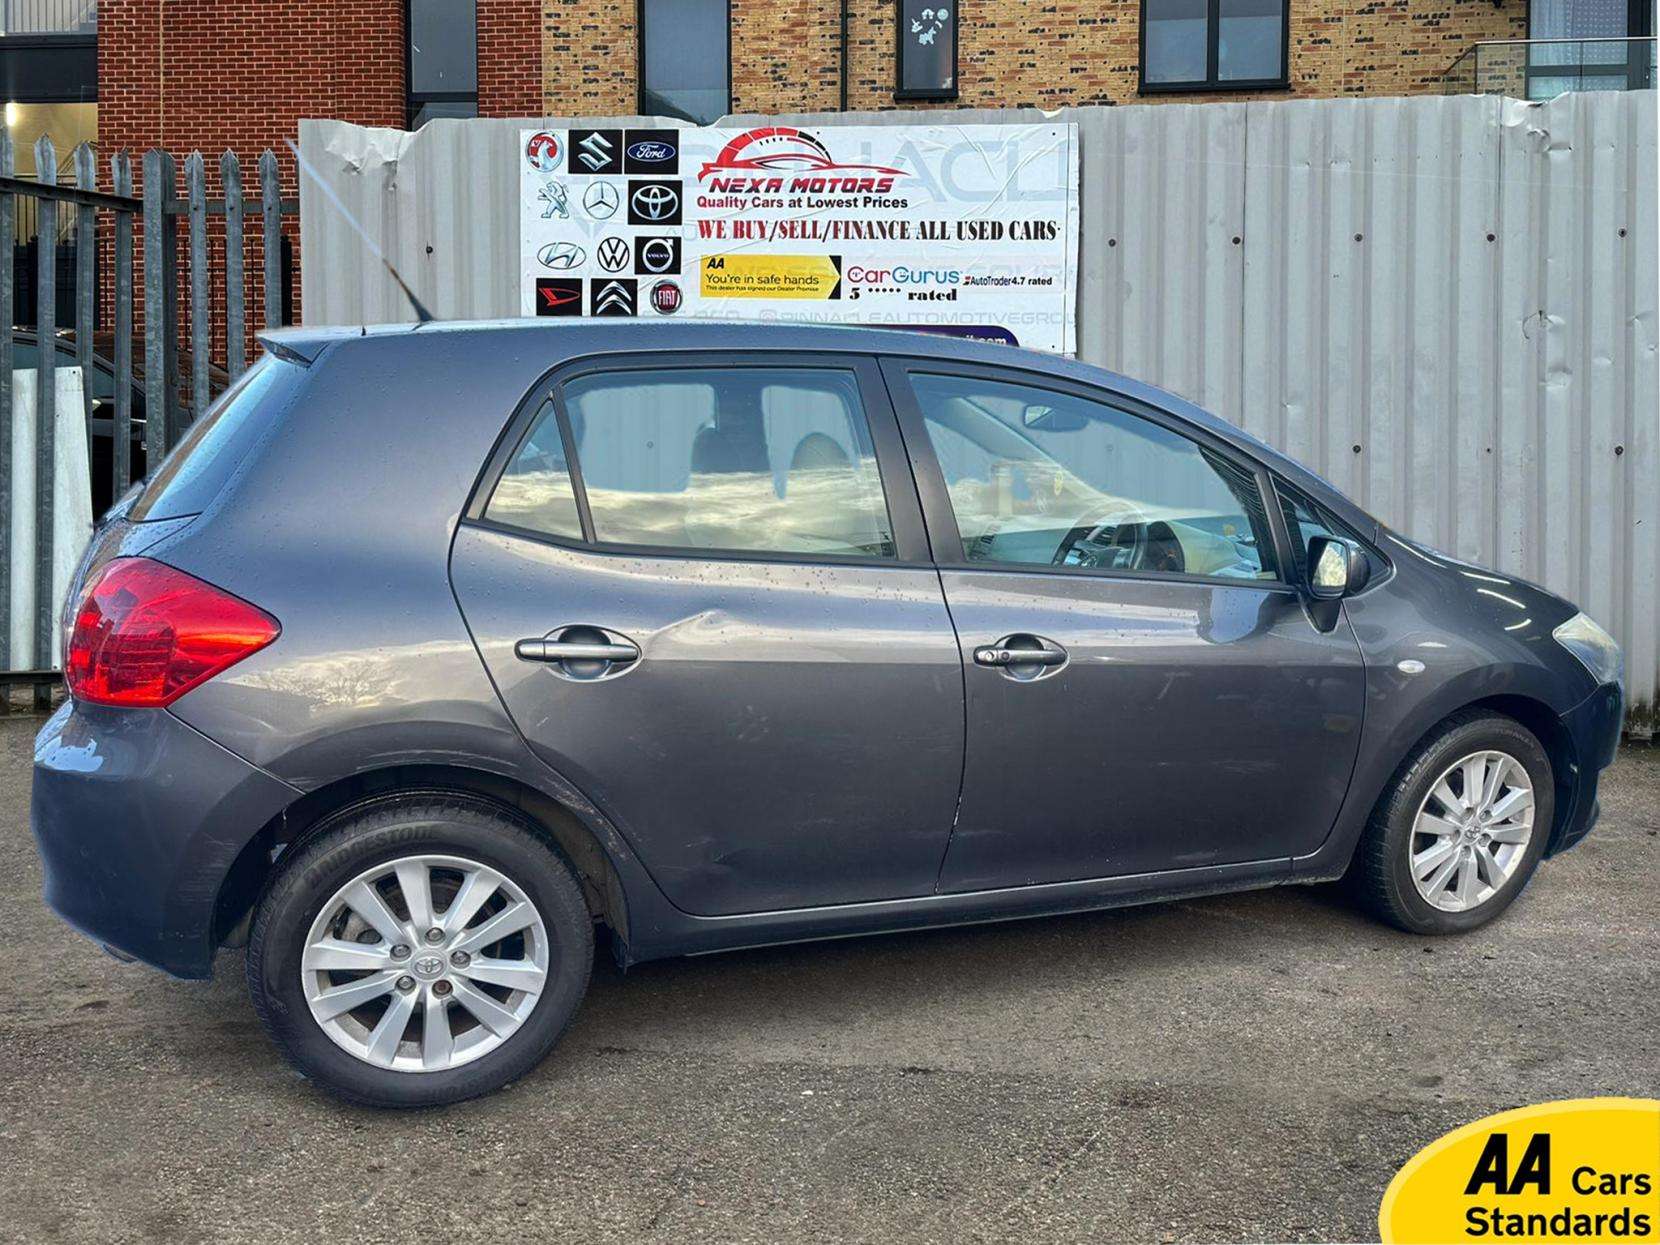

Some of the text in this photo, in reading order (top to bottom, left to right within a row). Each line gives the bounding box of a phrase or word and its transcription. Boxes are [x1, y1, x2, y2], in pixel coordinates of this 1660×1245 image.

[636, 143, 666, 159] Ford
[709, 177, 895, 193] NEXA MOTORS
[697, 196, 908, 209] Quality Cars at Lowest Prices
[698, 220, 726, 240] WE
[916, 220, 951, 241] ALL
[957, 220, 1003, 241] USED
[706, 257, 725, 269] AA
[706, 274, 819, 285] You're in safe hands
[847, 266, 960, 284] CarGurus
[1028, 277, 1052, 286] rated
[658, 290, 677, 306] FIAT
[849, 288, 958, 301] 5 rated
